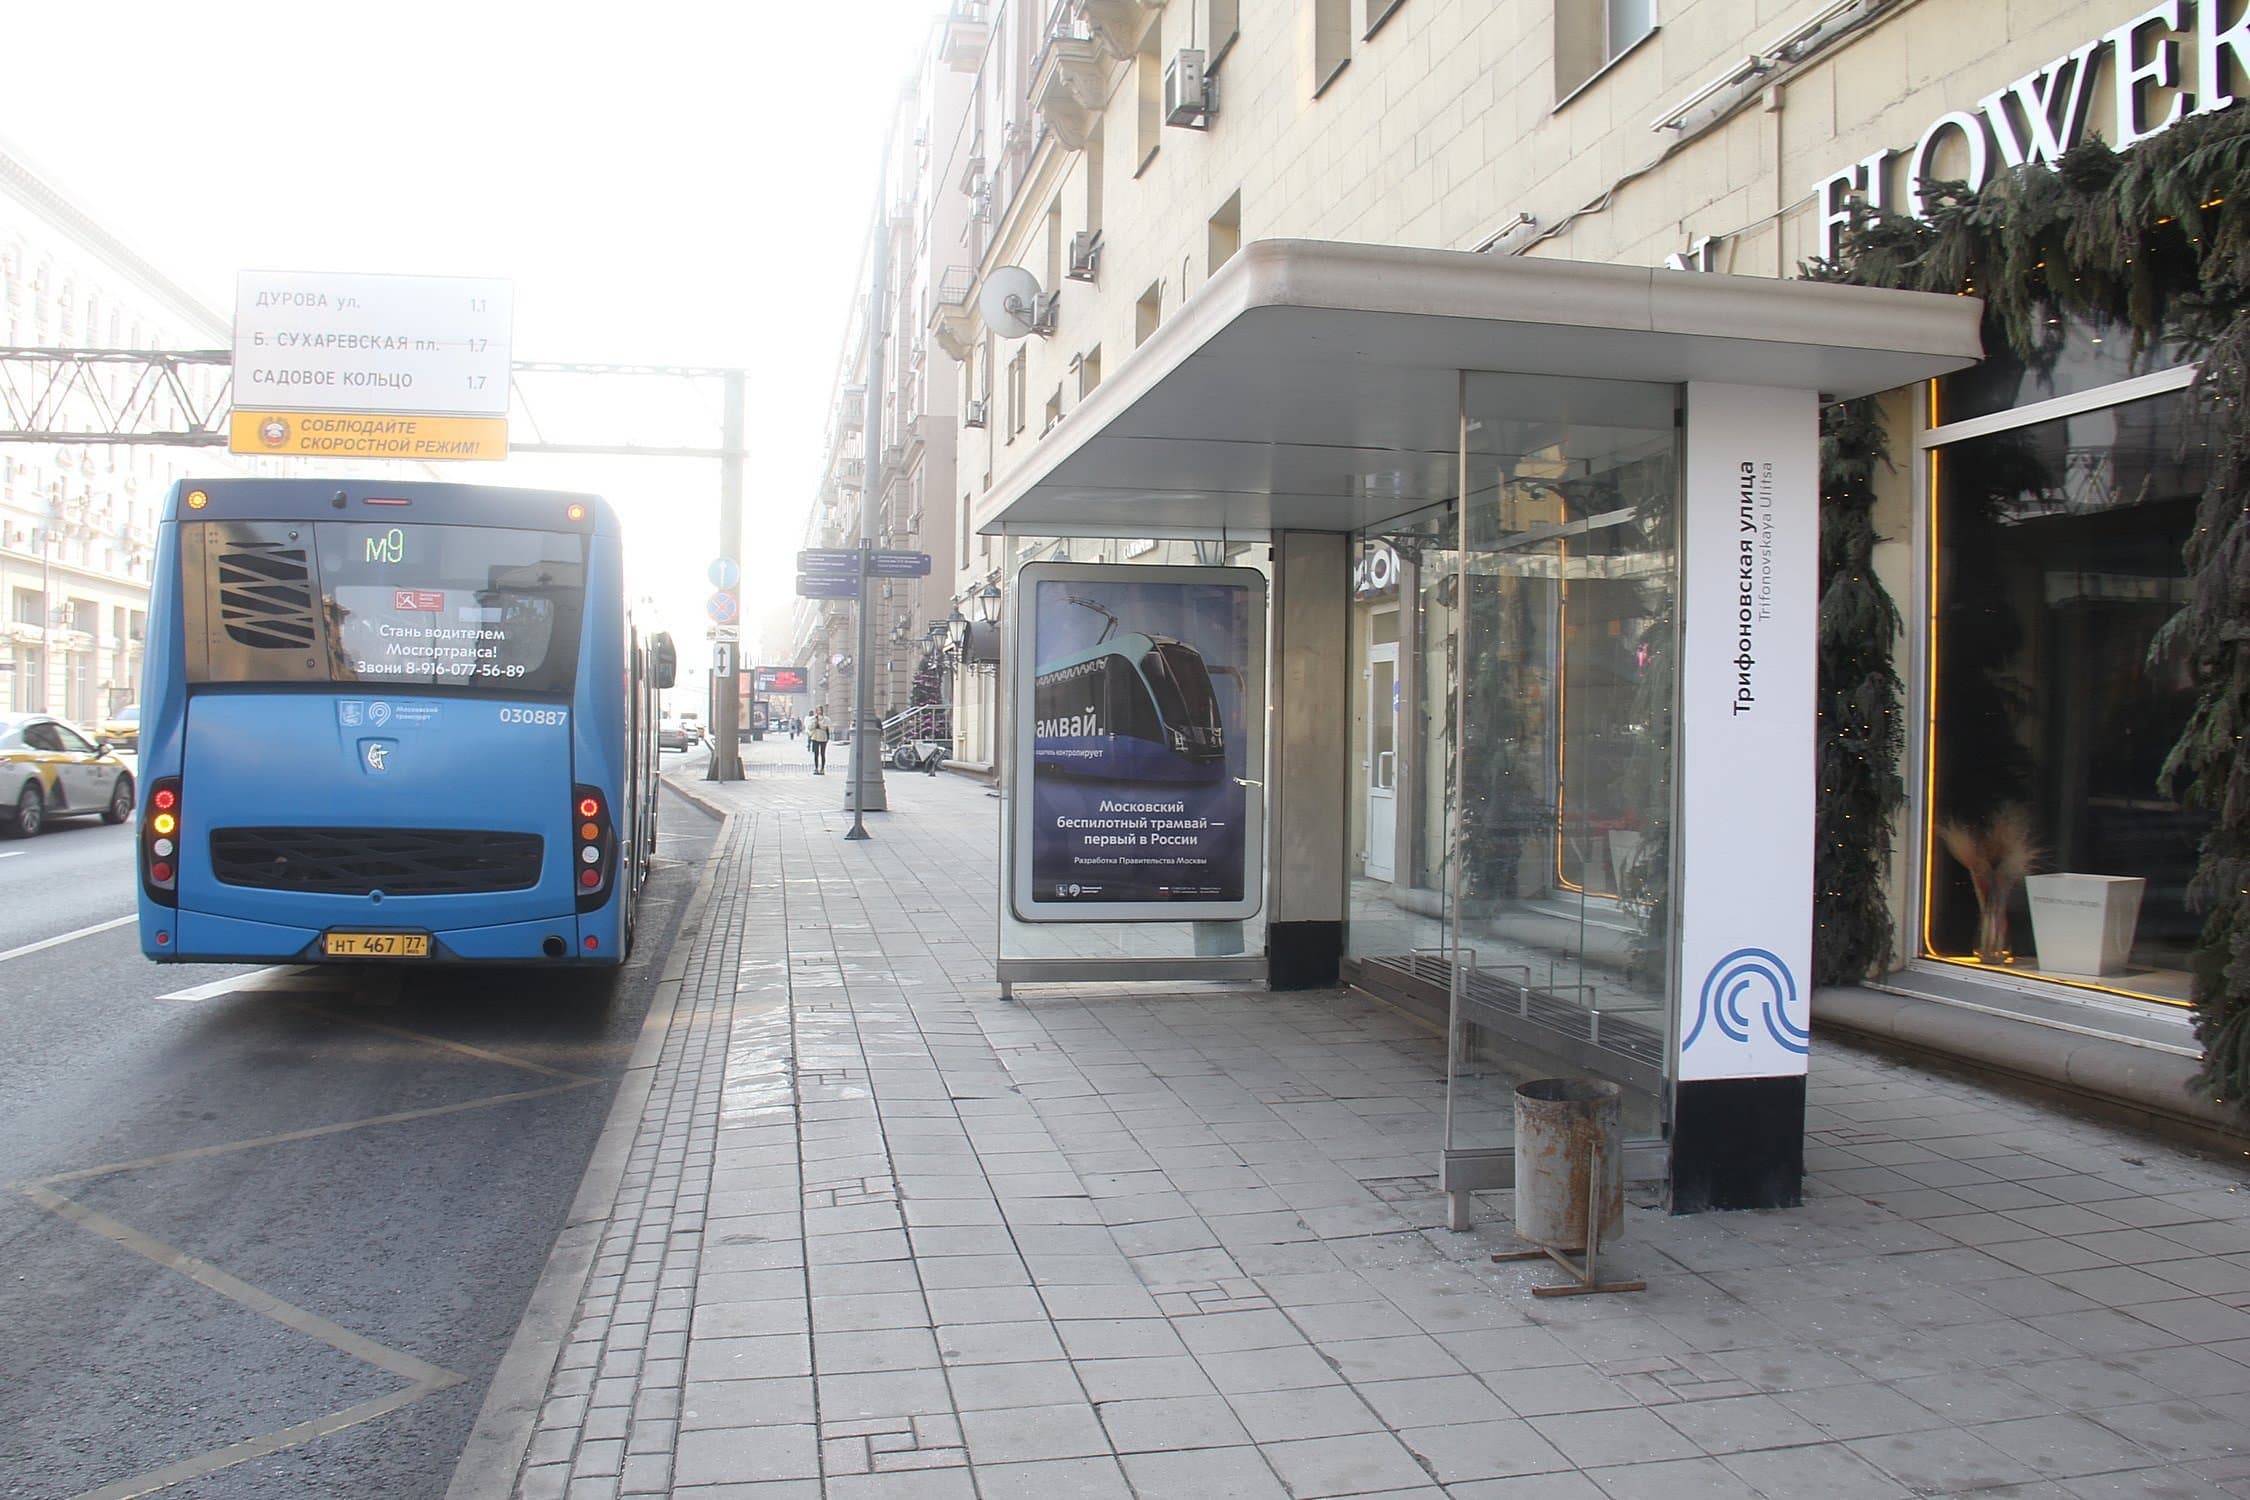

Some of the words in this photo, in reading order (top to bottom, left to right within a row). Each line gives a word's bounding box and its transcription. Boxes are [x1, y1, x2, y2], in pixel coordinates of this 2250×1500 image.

[256, 291, 328, 308] ДУРОВА
[336, 297, 360, 311] ул.
[469, 299, 487, 313] 1.1
[254, 332, 268, 346] Б.
[277, 332, 408, 350] СУХАРЕВСКАЯ
[415, 339, 440, 351] пл.
[468, 339, 488, 353] 1.7
[252, 369, 335, 386] САДОВОЕ
[343, 372, 413, 389] КОЛЬЦО
[466, 376, 487, 390] 1.7
[300, 418, 417, 435] СОБЛЮДАЙТЕ
[300, 437, 411, 453] СКОРОСТНОЙ
[414, 439, 480, 455] РЕЖИМ!
[1759, 462, 1773, 508] Ulitsa
[1739, 461, 1757, 533] улица
[1758, 513, 1775, 622] Trifonovskaya
[379, 624, 421, 638] Стань
[424, 627, 506, 641] водителем
[1733, 540, 1756, 716] Трифоновская
[385, 642, 498, 660] Мосгортранса!
[357, 660, 402, 675] Звони
[406, 662, 525, 678] 8-916-077-56-89
[499, 708, 568, 726] 030887
[1099, 800, 1184, 813] Московский
[1056, 816, 1148, 829] беспилотный
[1151, 818, 1208, 831] трамвай
[1084, 833, 1136, 847] первый
[1139, 836, 1148, 845] в
[1151, 833, 1198, 845] России
[1074, 857, 1117, 866] Разработка
[1119, 857, 1175, 867] Правительства
[1176, 858, 1208, 866] Москвы
[363, 937, 395, 953] 467
[405, 936, 422, 948] 77
